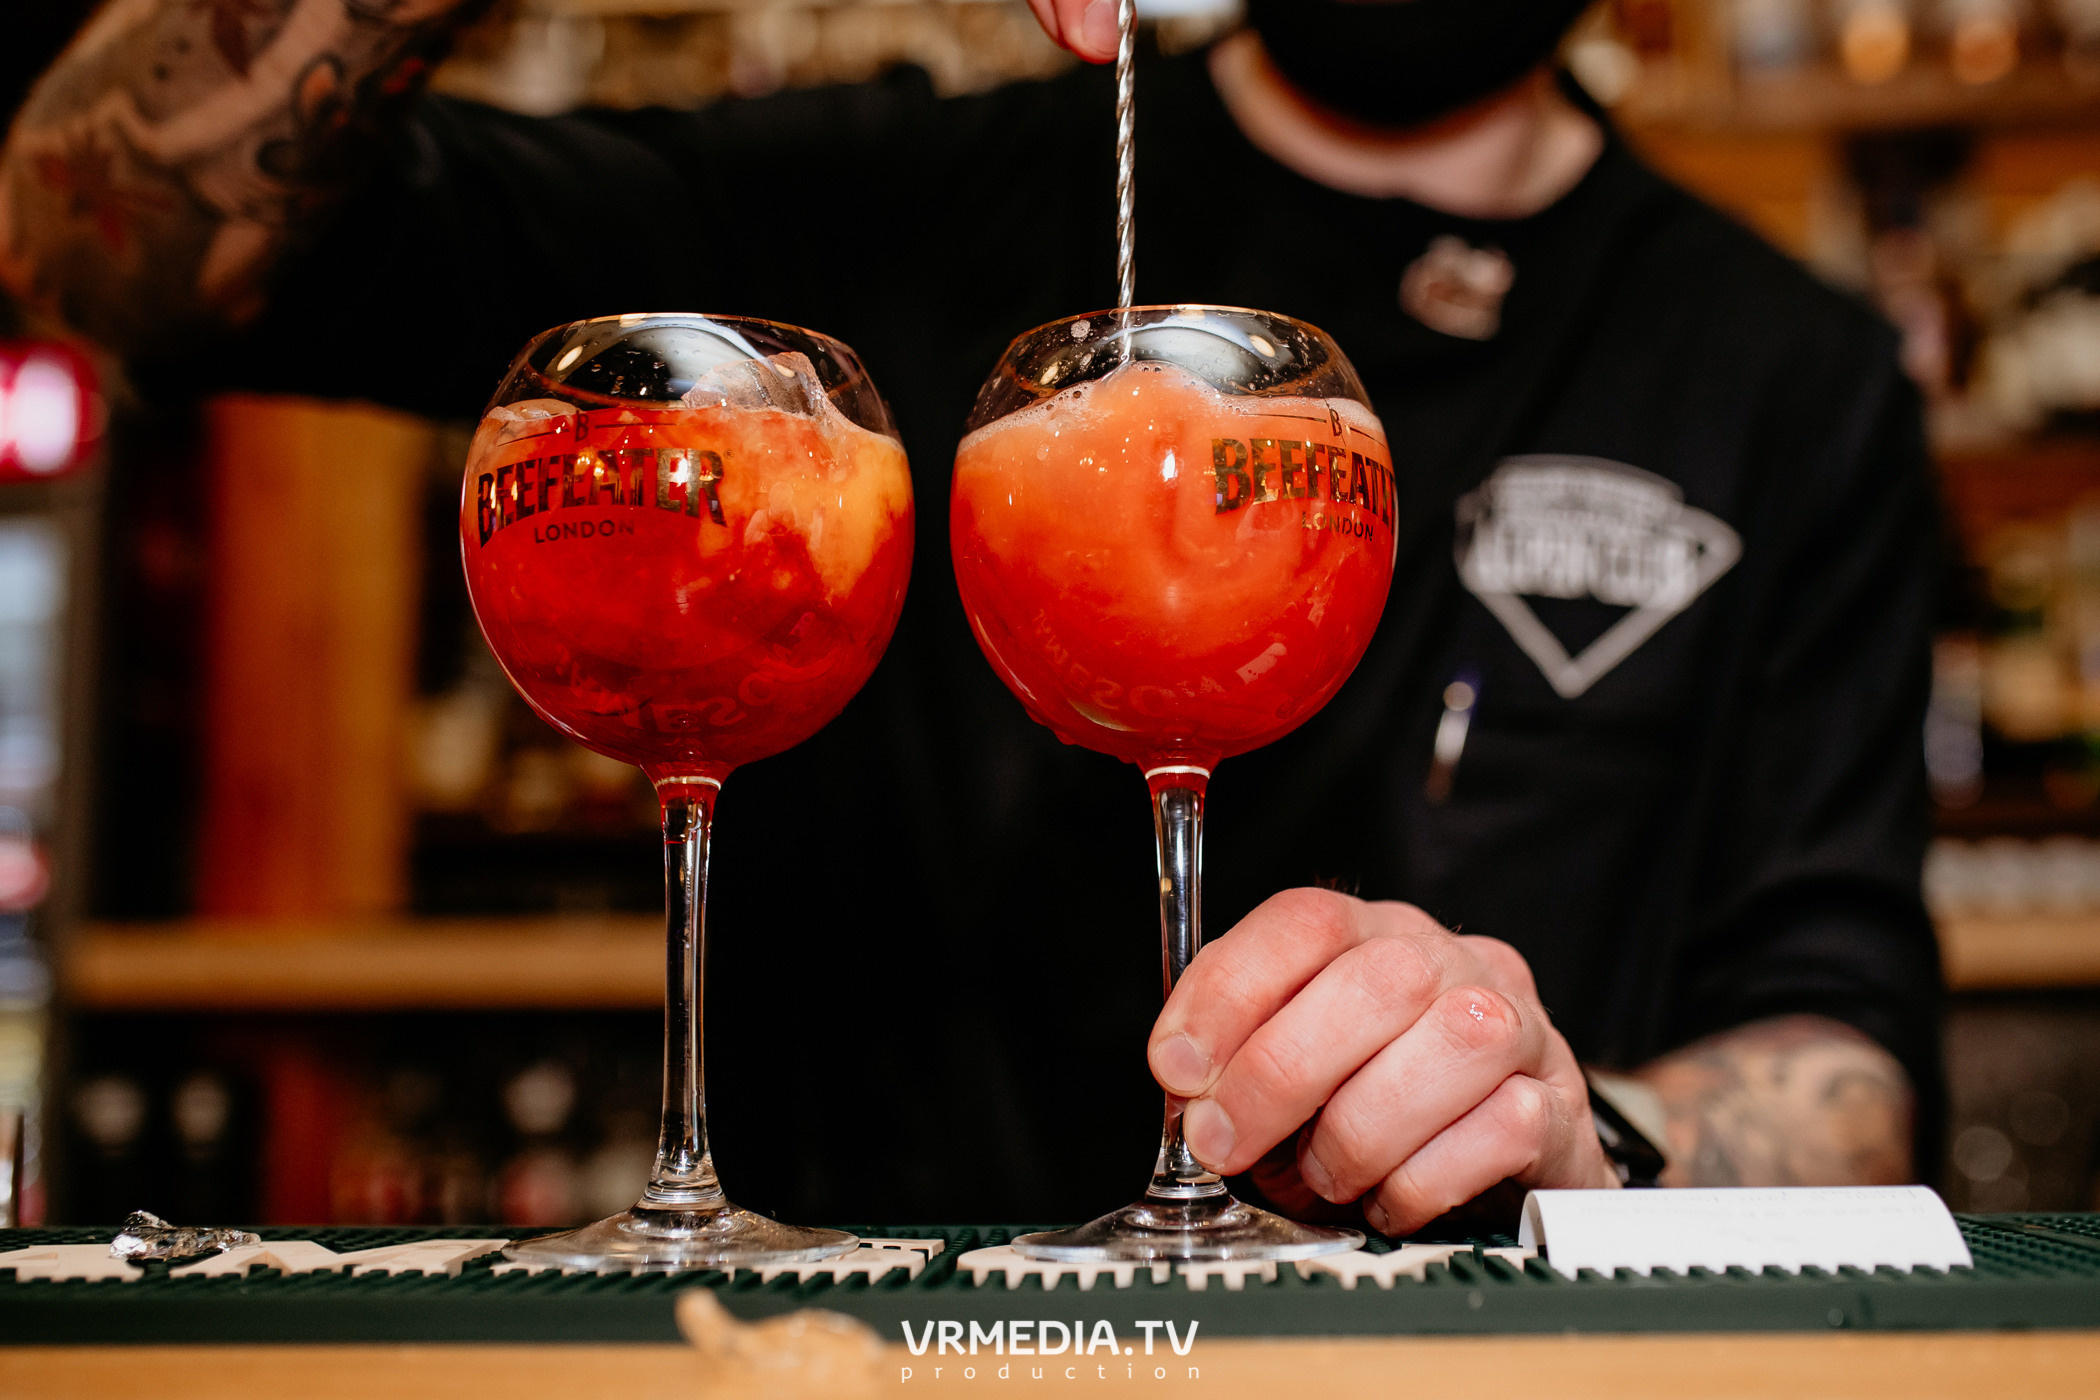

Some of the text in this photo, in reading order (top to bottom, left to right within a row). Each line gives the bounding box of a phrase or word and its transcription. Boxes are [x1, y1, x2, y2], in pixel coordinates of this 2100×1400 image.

[1329, 408, 1343, 437] B
[477, 447, 728, 549] BEEFEATER
[534, 519, 635, 544] LONDON
[1302, 511, 1374, 542] LONDON
